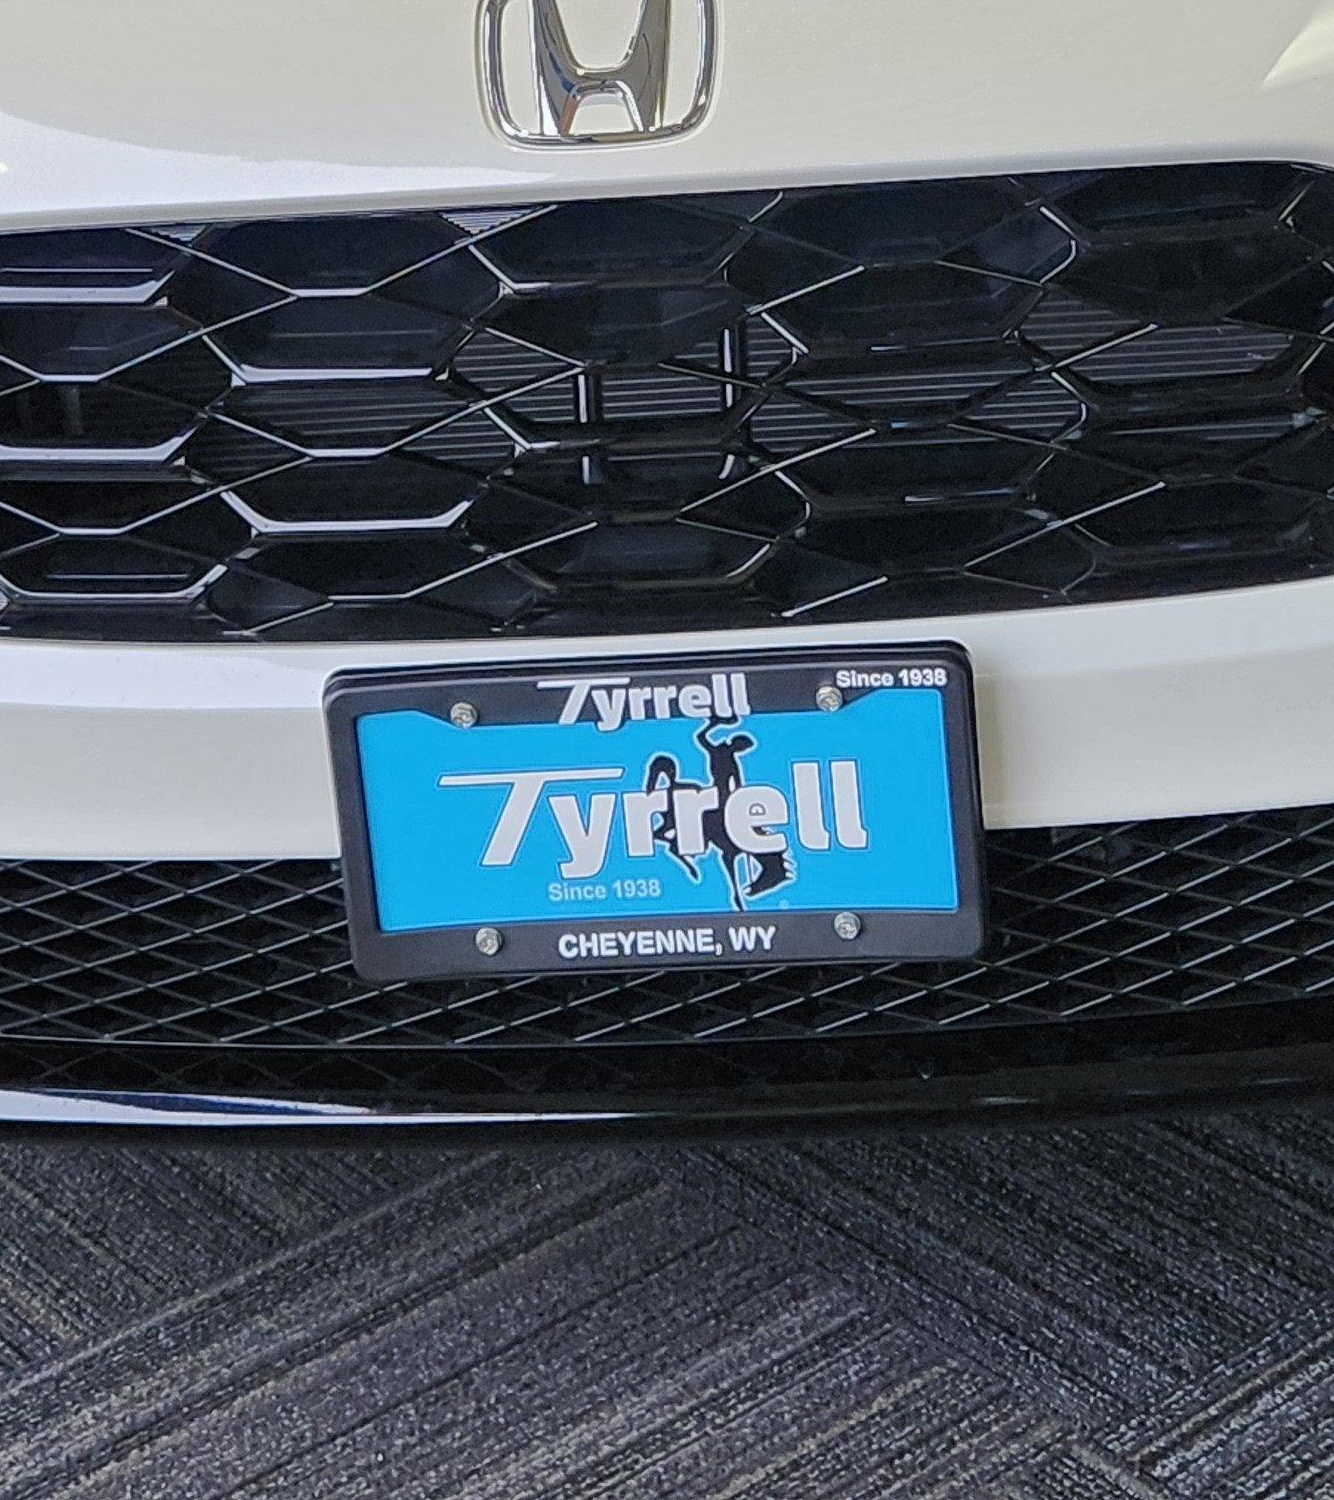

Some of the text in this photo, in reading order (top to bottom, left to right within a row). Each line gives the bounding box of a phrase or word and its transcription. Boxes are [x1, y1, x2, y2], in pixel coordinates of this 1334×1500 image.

[835, 667, 948, 688] Since 1938
[536, 672, 752, 732] Tyrrell
[437, 760, 869, 879] Tyrrell
[548, 879, 661, 900] Since 1938
[558, 925, 776, 959] CHEYENNE, WY
